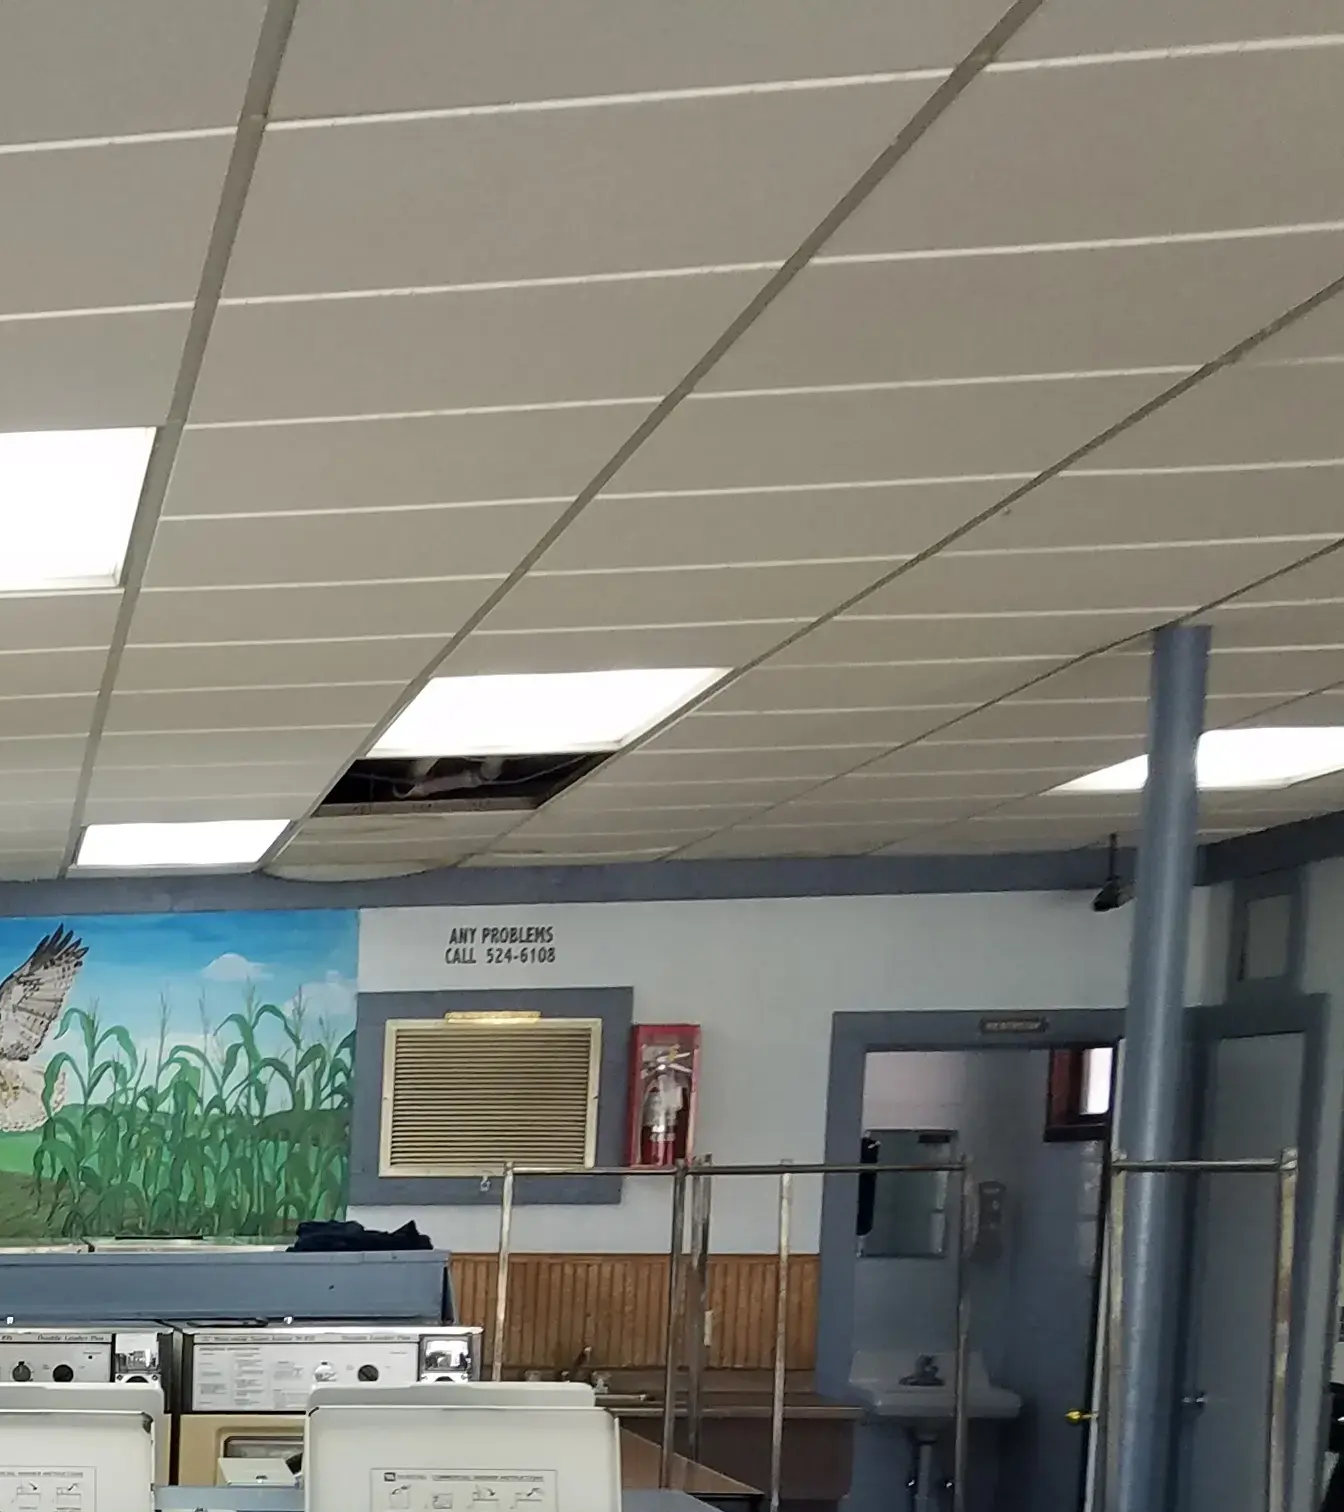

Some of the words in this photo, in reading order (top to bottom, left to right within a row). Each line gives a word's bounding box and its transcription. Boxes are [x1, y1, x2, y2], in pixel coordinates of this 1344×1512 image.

[449, 928, 476, 944] ANY
[482, 927, 553, 944] PROBLEMS
[445, 948, 477, 964] CALL
[486, 947, 555, 964] 524-6108
